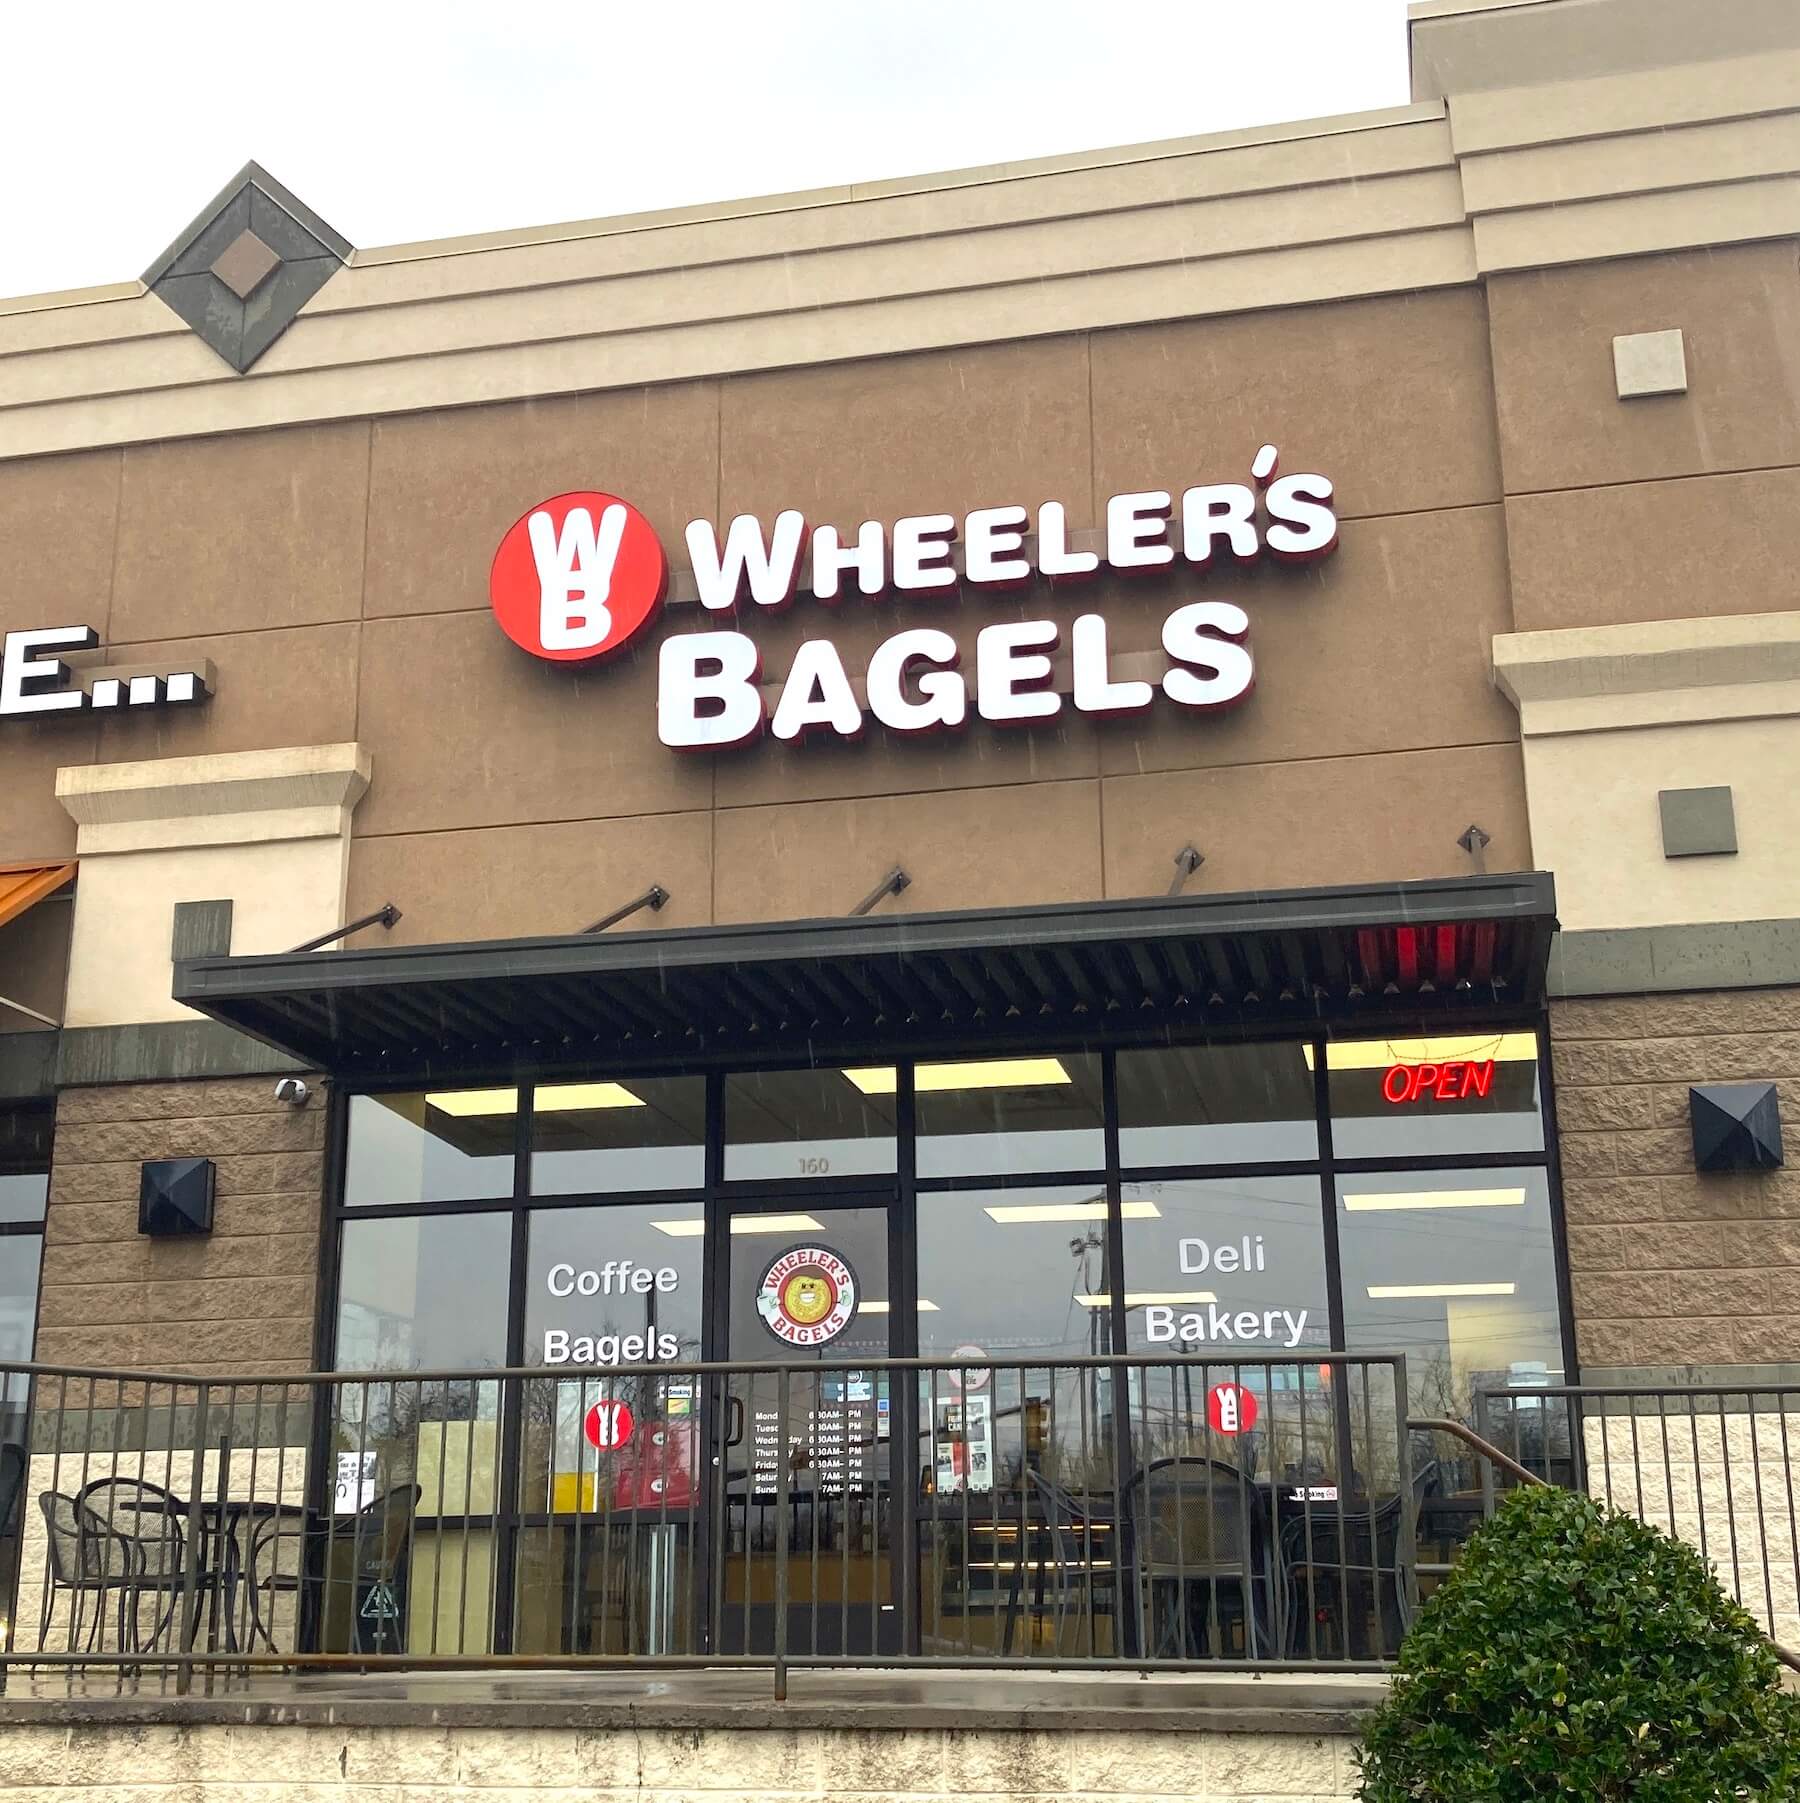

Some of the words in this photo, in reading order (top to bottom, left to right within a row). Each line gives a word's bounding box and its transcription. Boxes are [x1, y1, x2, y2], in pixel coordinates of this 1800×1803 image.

[684, 443, 1338, 610] WHEELER'S
[657, 601, 1255, 748] BAGELS
[1383, 1059, 1495, 1103] OPEN
[798, 1158, 829, 1174] 160
[765, 1251, 850, 1290] WHEELER'S
[1178, 1235, 1265, 1274] Deli
[547, 1261, 679, 1297] Coffee
[772, 1313, 844, 1342] BAGELS
[1145, 1303, 1308, 1348] Bakery
[544, 1325, 679, 1367] Bagels
[755, 1435, 802, 1445] Wednday
[755, 1448, 793, 1458] Thursy
[1300, 1490, 1325, 1498] Soking
